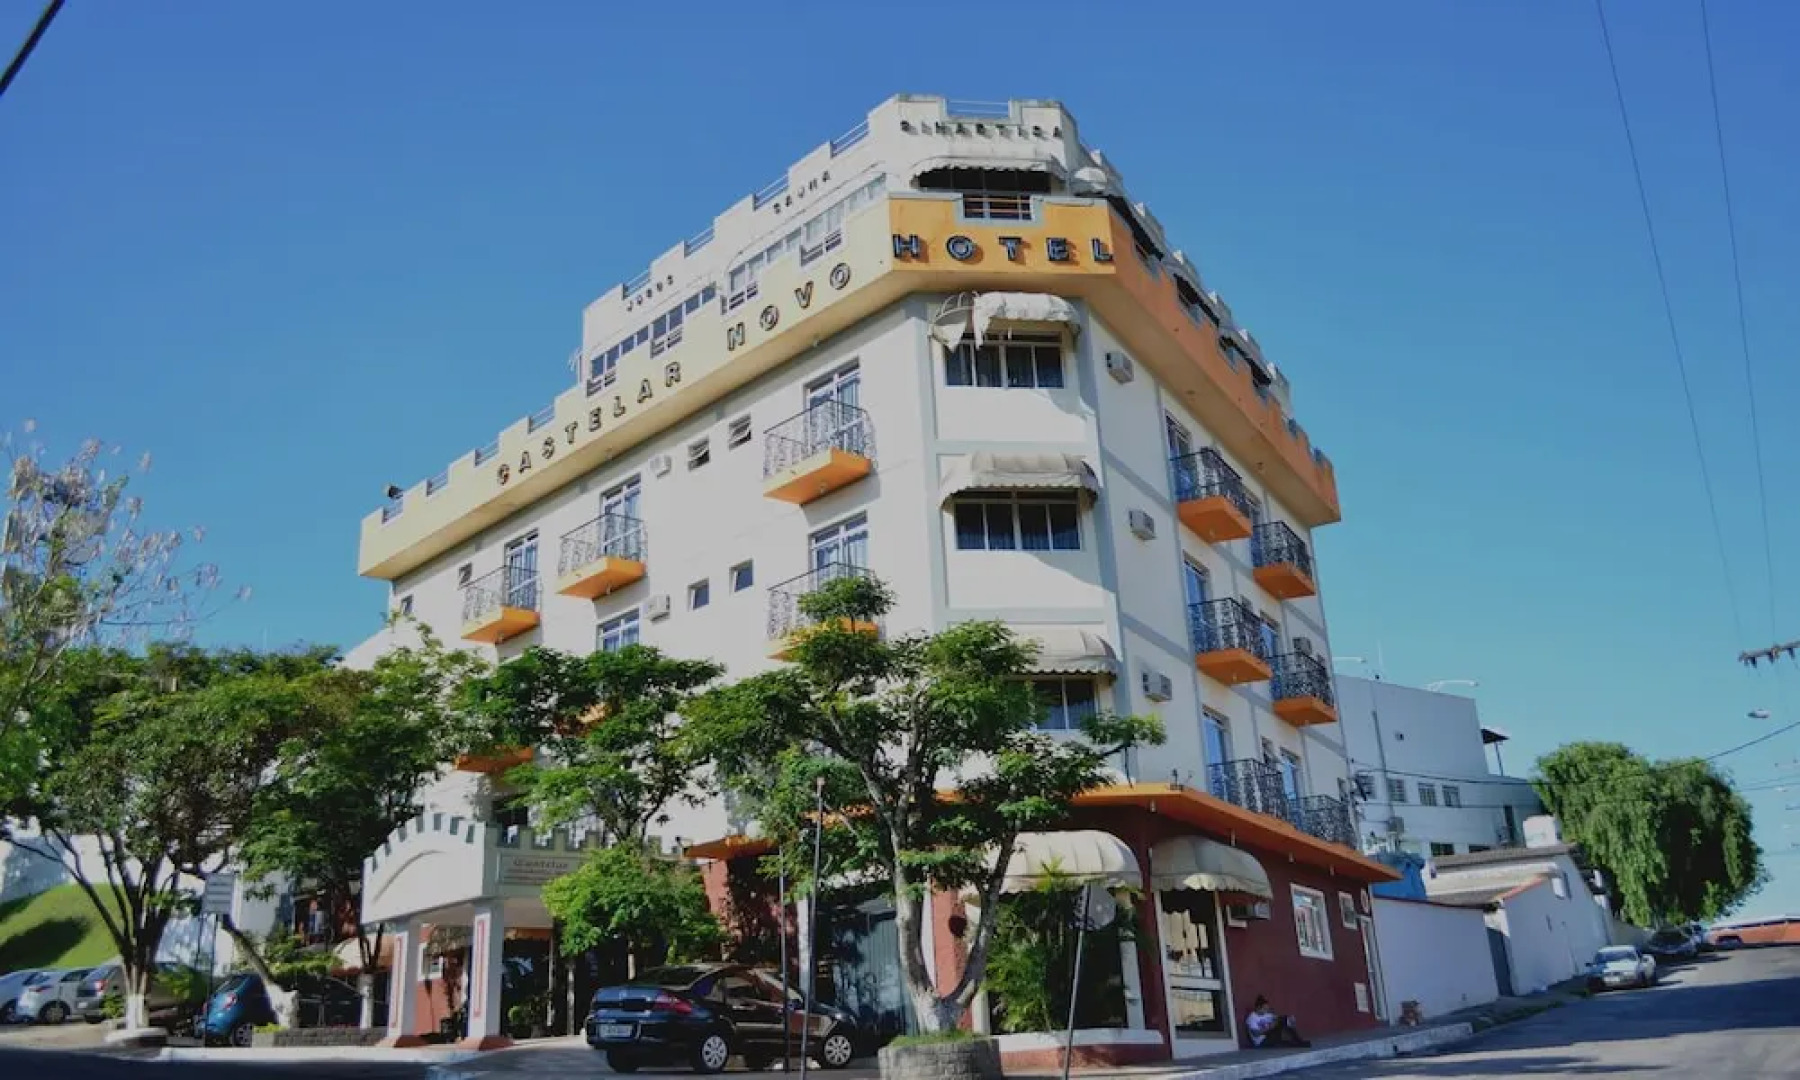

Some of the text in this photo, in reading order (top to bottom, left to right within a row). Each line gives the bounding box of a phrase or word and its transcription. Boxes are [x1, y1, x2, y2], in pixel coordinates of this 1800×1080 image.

[892, 233, 1114, 262] HOTEL
[496, 261, 851, 487] CASTELAR NOVO
